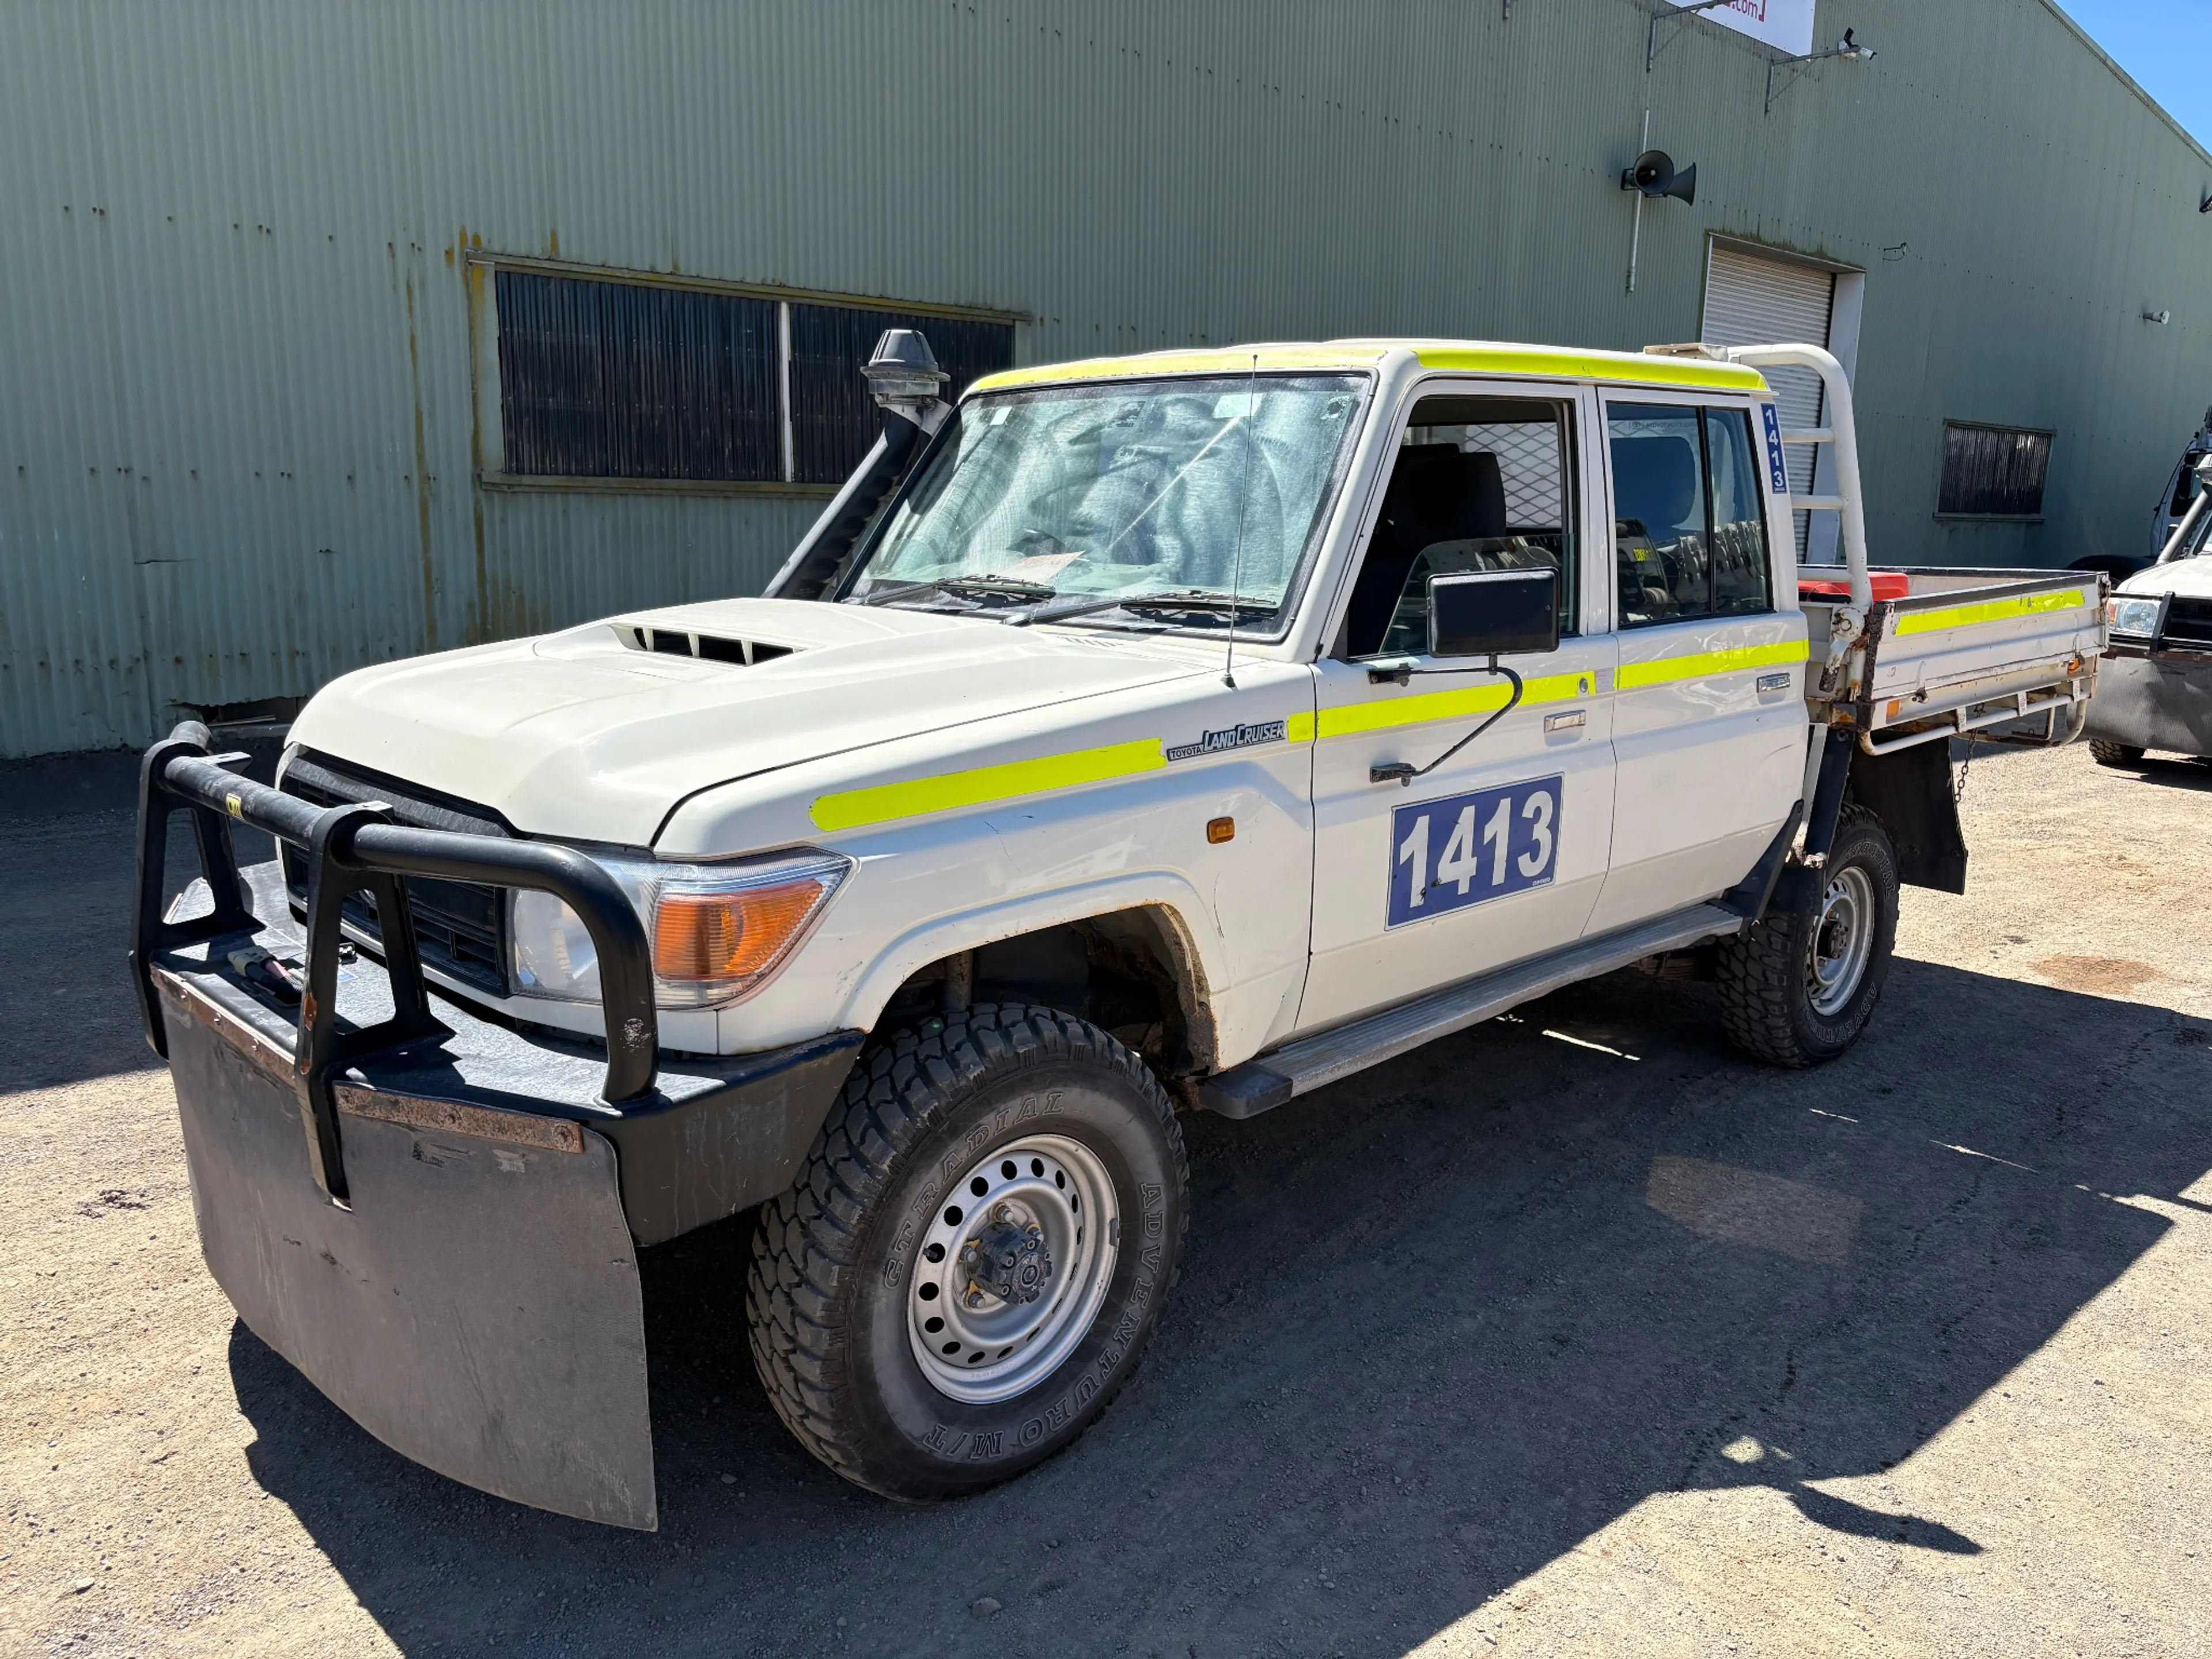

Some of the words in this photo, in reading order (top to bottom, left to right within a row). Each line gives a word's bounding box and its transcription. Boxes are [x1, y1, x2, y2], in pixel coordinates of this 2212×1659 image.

[1766, 409, 1783, 487] 1413
[1171, 745, 1202, 760] TOYOTA
[1400, 790, 1553, 908] 1413
[883, 1219, 916, 1289] GT
[912, 1092, 1065, 1221] RADIAL
[1018, 1182, 1166, 1448] ADVENTURO
[922, 1423, 1005, 1460] M/T
